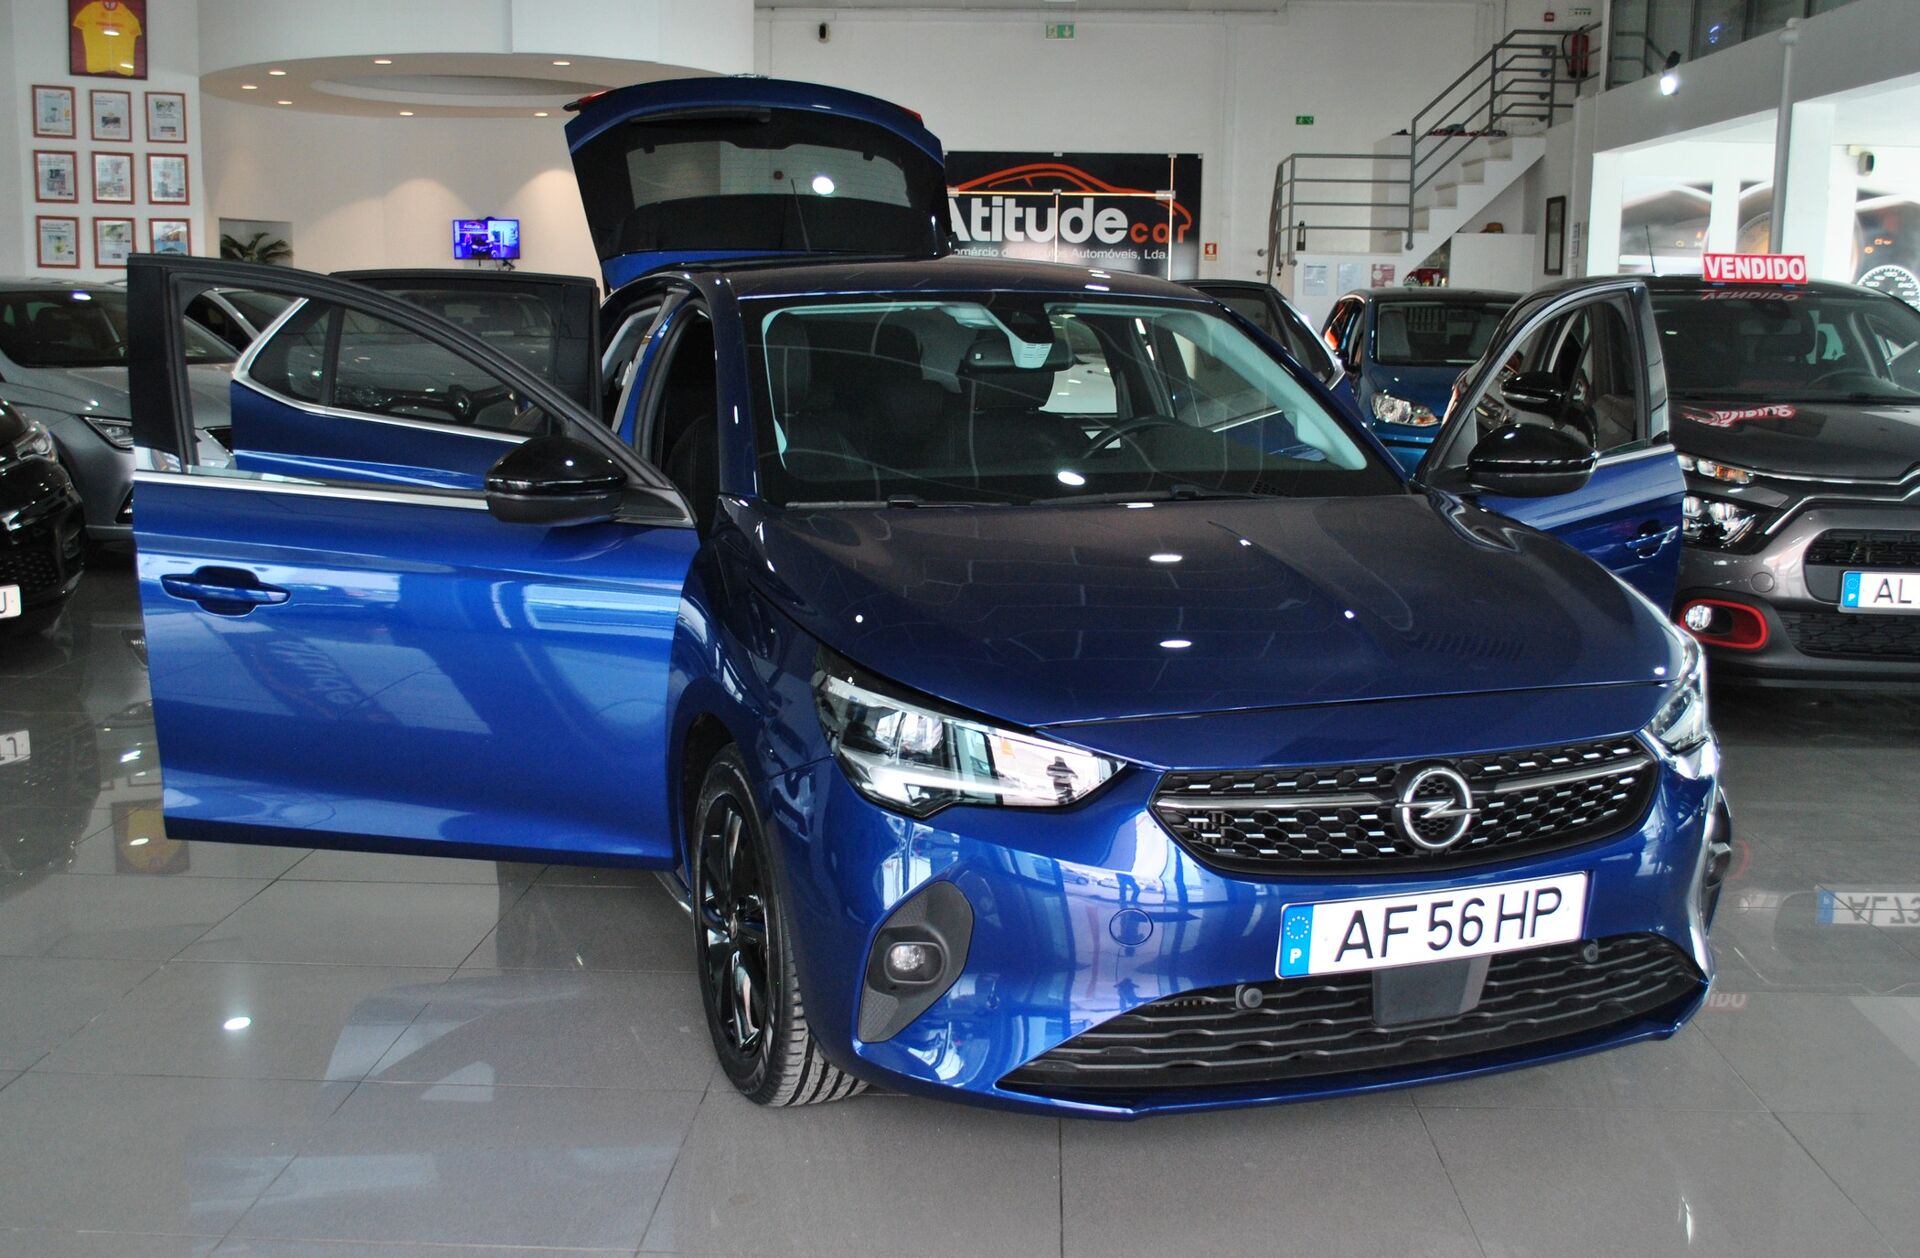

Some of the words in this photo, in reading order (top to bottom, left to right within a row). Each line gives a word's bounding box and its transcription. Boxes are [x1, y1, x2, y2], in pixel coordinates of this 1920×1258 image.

[953, 247, 999, 257] omércio
[1704, 256, 1805, 280] VENDIDO
[1873, 578, 1912, 604] AL
[1334, 904, 1418, 962] AF
[1427, 898, 1485, 951] 56
[1494, 886, 1562, 943] HP
[1289, 948, 1302, 964] P
